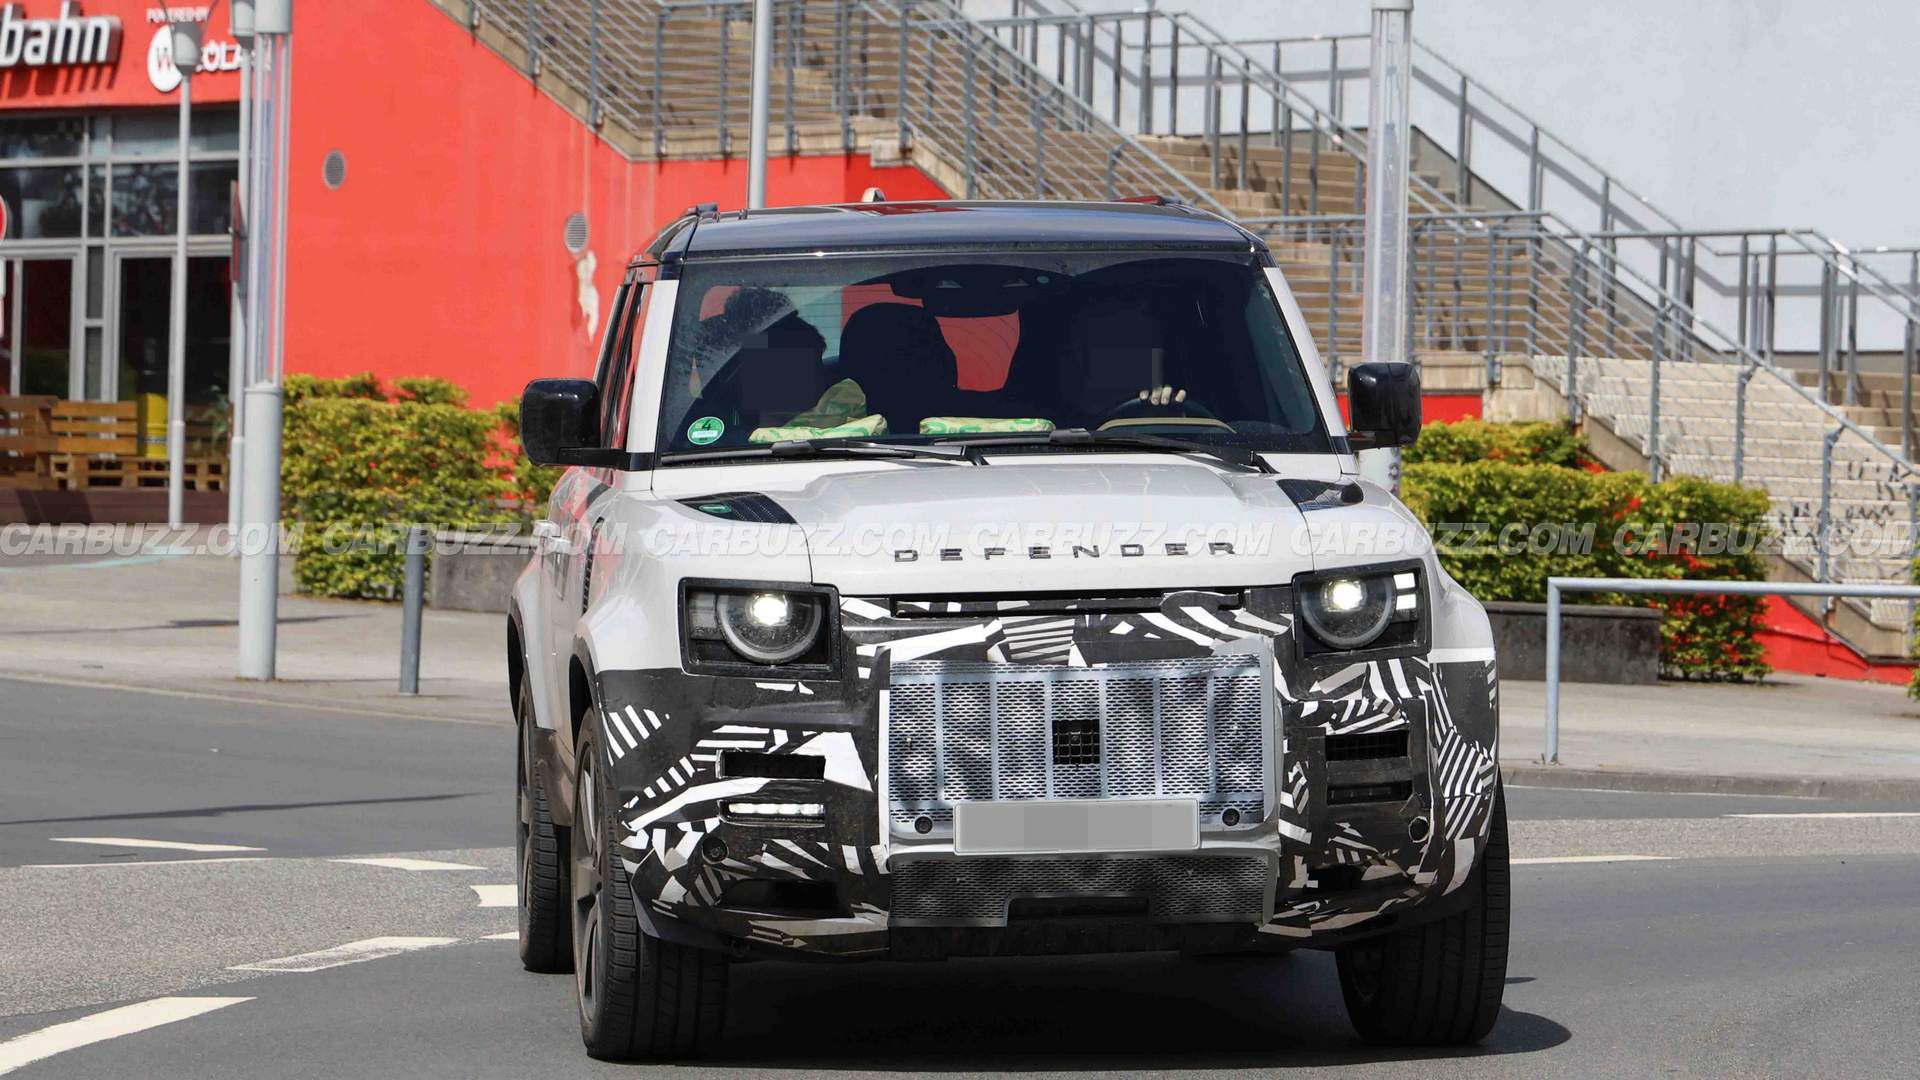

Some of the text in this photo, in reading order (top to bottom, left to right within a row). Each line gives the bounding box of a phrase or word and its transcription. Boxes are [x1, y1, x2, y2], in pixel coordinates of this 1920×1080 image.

[0, 1, 113, 66] bahn
[702, 418, 711, 430] 4
[894, 542, 1236, 562] DEFENDER
